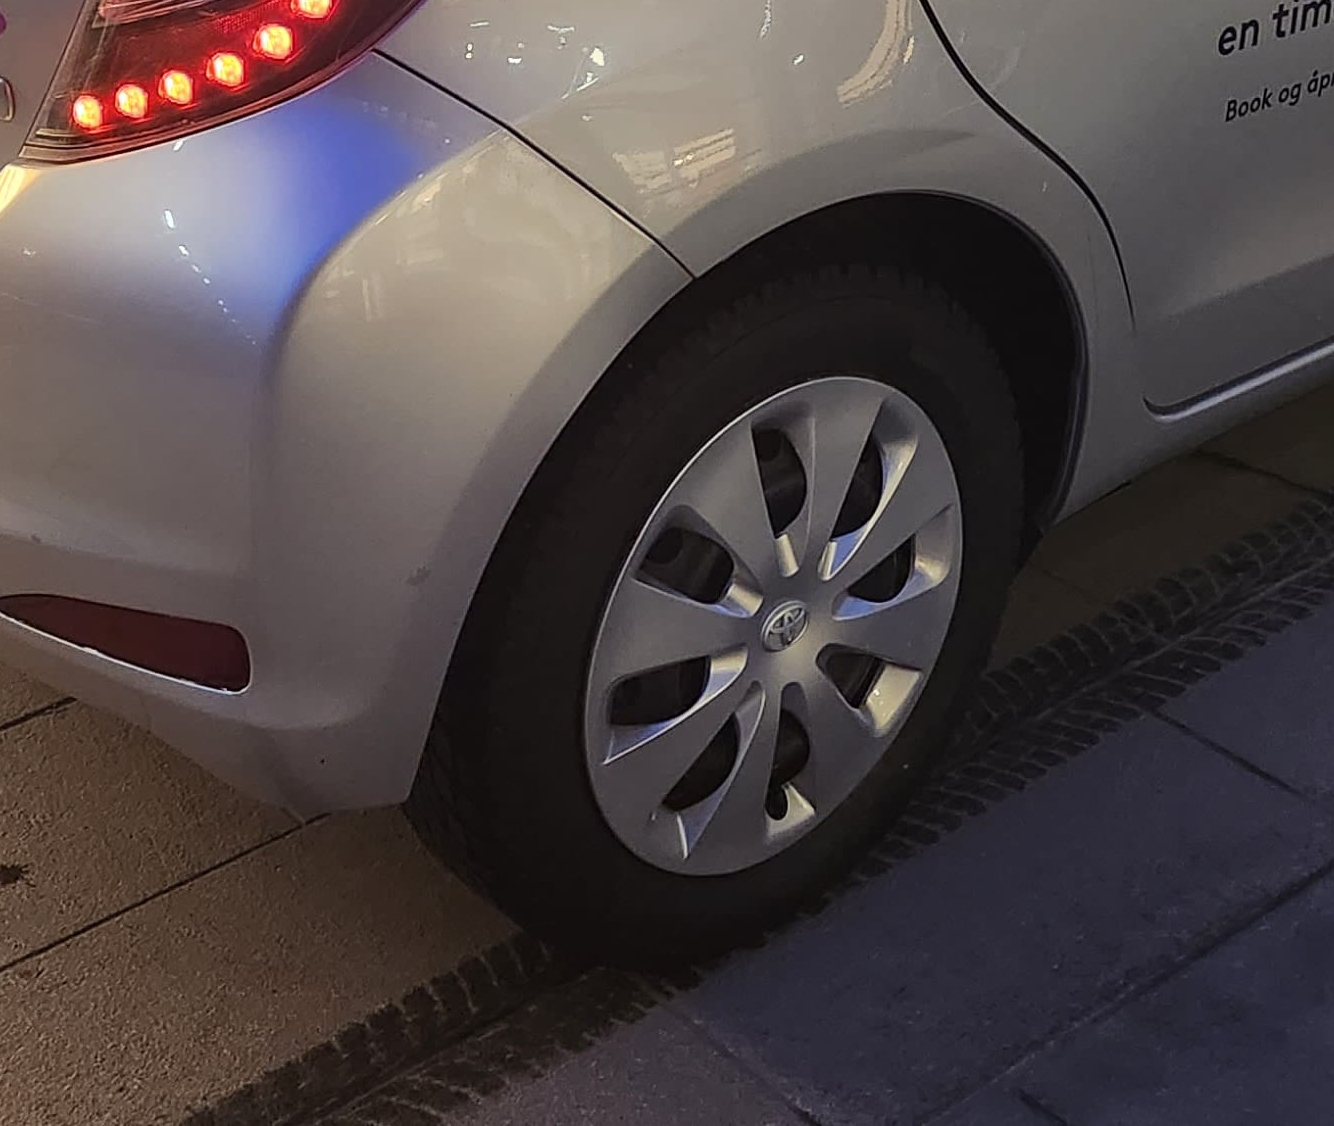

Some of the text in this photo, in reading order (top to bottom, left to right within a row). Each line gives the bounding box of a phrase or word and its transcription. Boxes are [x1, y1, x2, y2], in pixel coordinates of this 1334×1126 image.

[1217, 17, 1260, 57] en
[1225, 88, 1273, 123] Book
[1278, 80, 1303, 106] og
